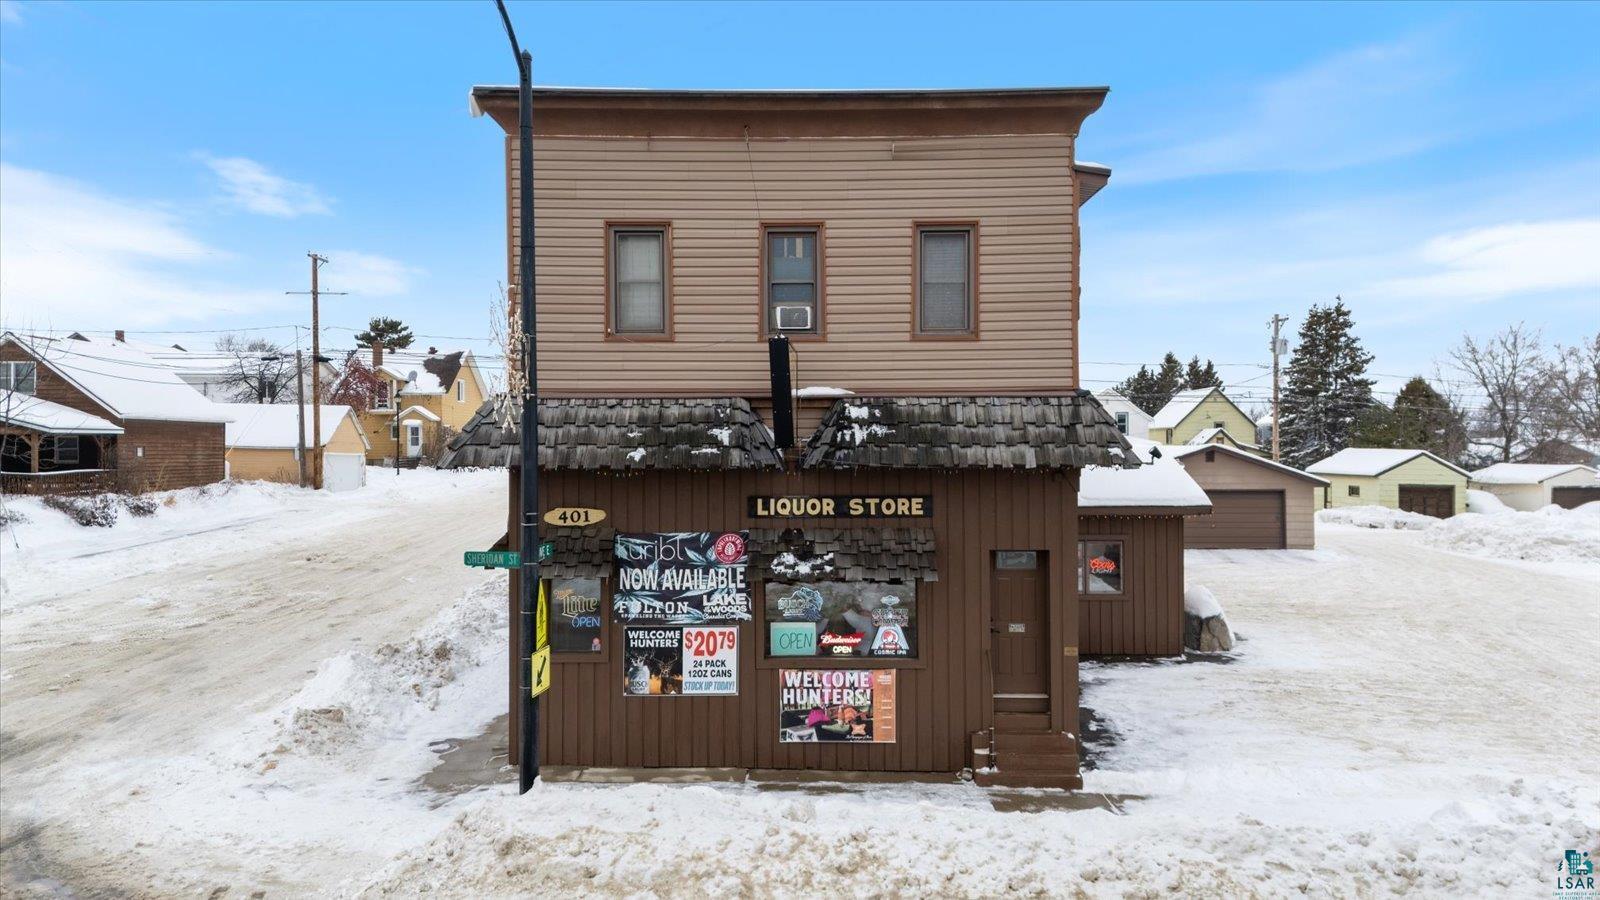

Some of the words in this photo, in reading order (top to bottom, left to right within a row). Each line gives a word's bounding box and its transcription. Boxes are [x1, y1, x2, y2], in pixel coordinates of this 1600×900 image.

[757, 498, 835, 516] LIQUOR
[849, 498, 924, 516] STORE
[558, 510, 591, 524] 401
[467, 553, 504, 565] SHERIDAN
[508, 554, 518, 566] ST
[619, 567, 660, 591] NOW
[661, 566, 746, 591] AVAILABLE
[702, 592, 747, 606] LAKE
[562, 595, 598, 618] Lite
[711, 605, 748, 613] WOODS
[572, 615, 601, 628] OPEN
[628, 630, 681, 640] WELCOME
[779, 632, 813, 650] OPEN
[820, 633, 862, 645] Budweiser
[630, 639, 679, 648] HUNTERS
[832, 645, 853, 654] OPEN
[693, 660, 703, 668] 24
[705, 660, 726, 668] PACK
[710, 669, 732, 678] CANS
[784, 671, 871, 688] WELCOME
[683, 681, 704, 692] STOCK
[704, 681, 713, 692] UP
[713, 681, 735, 692] TODAY!
[783, 688, 872, 706] HUNTERS!
